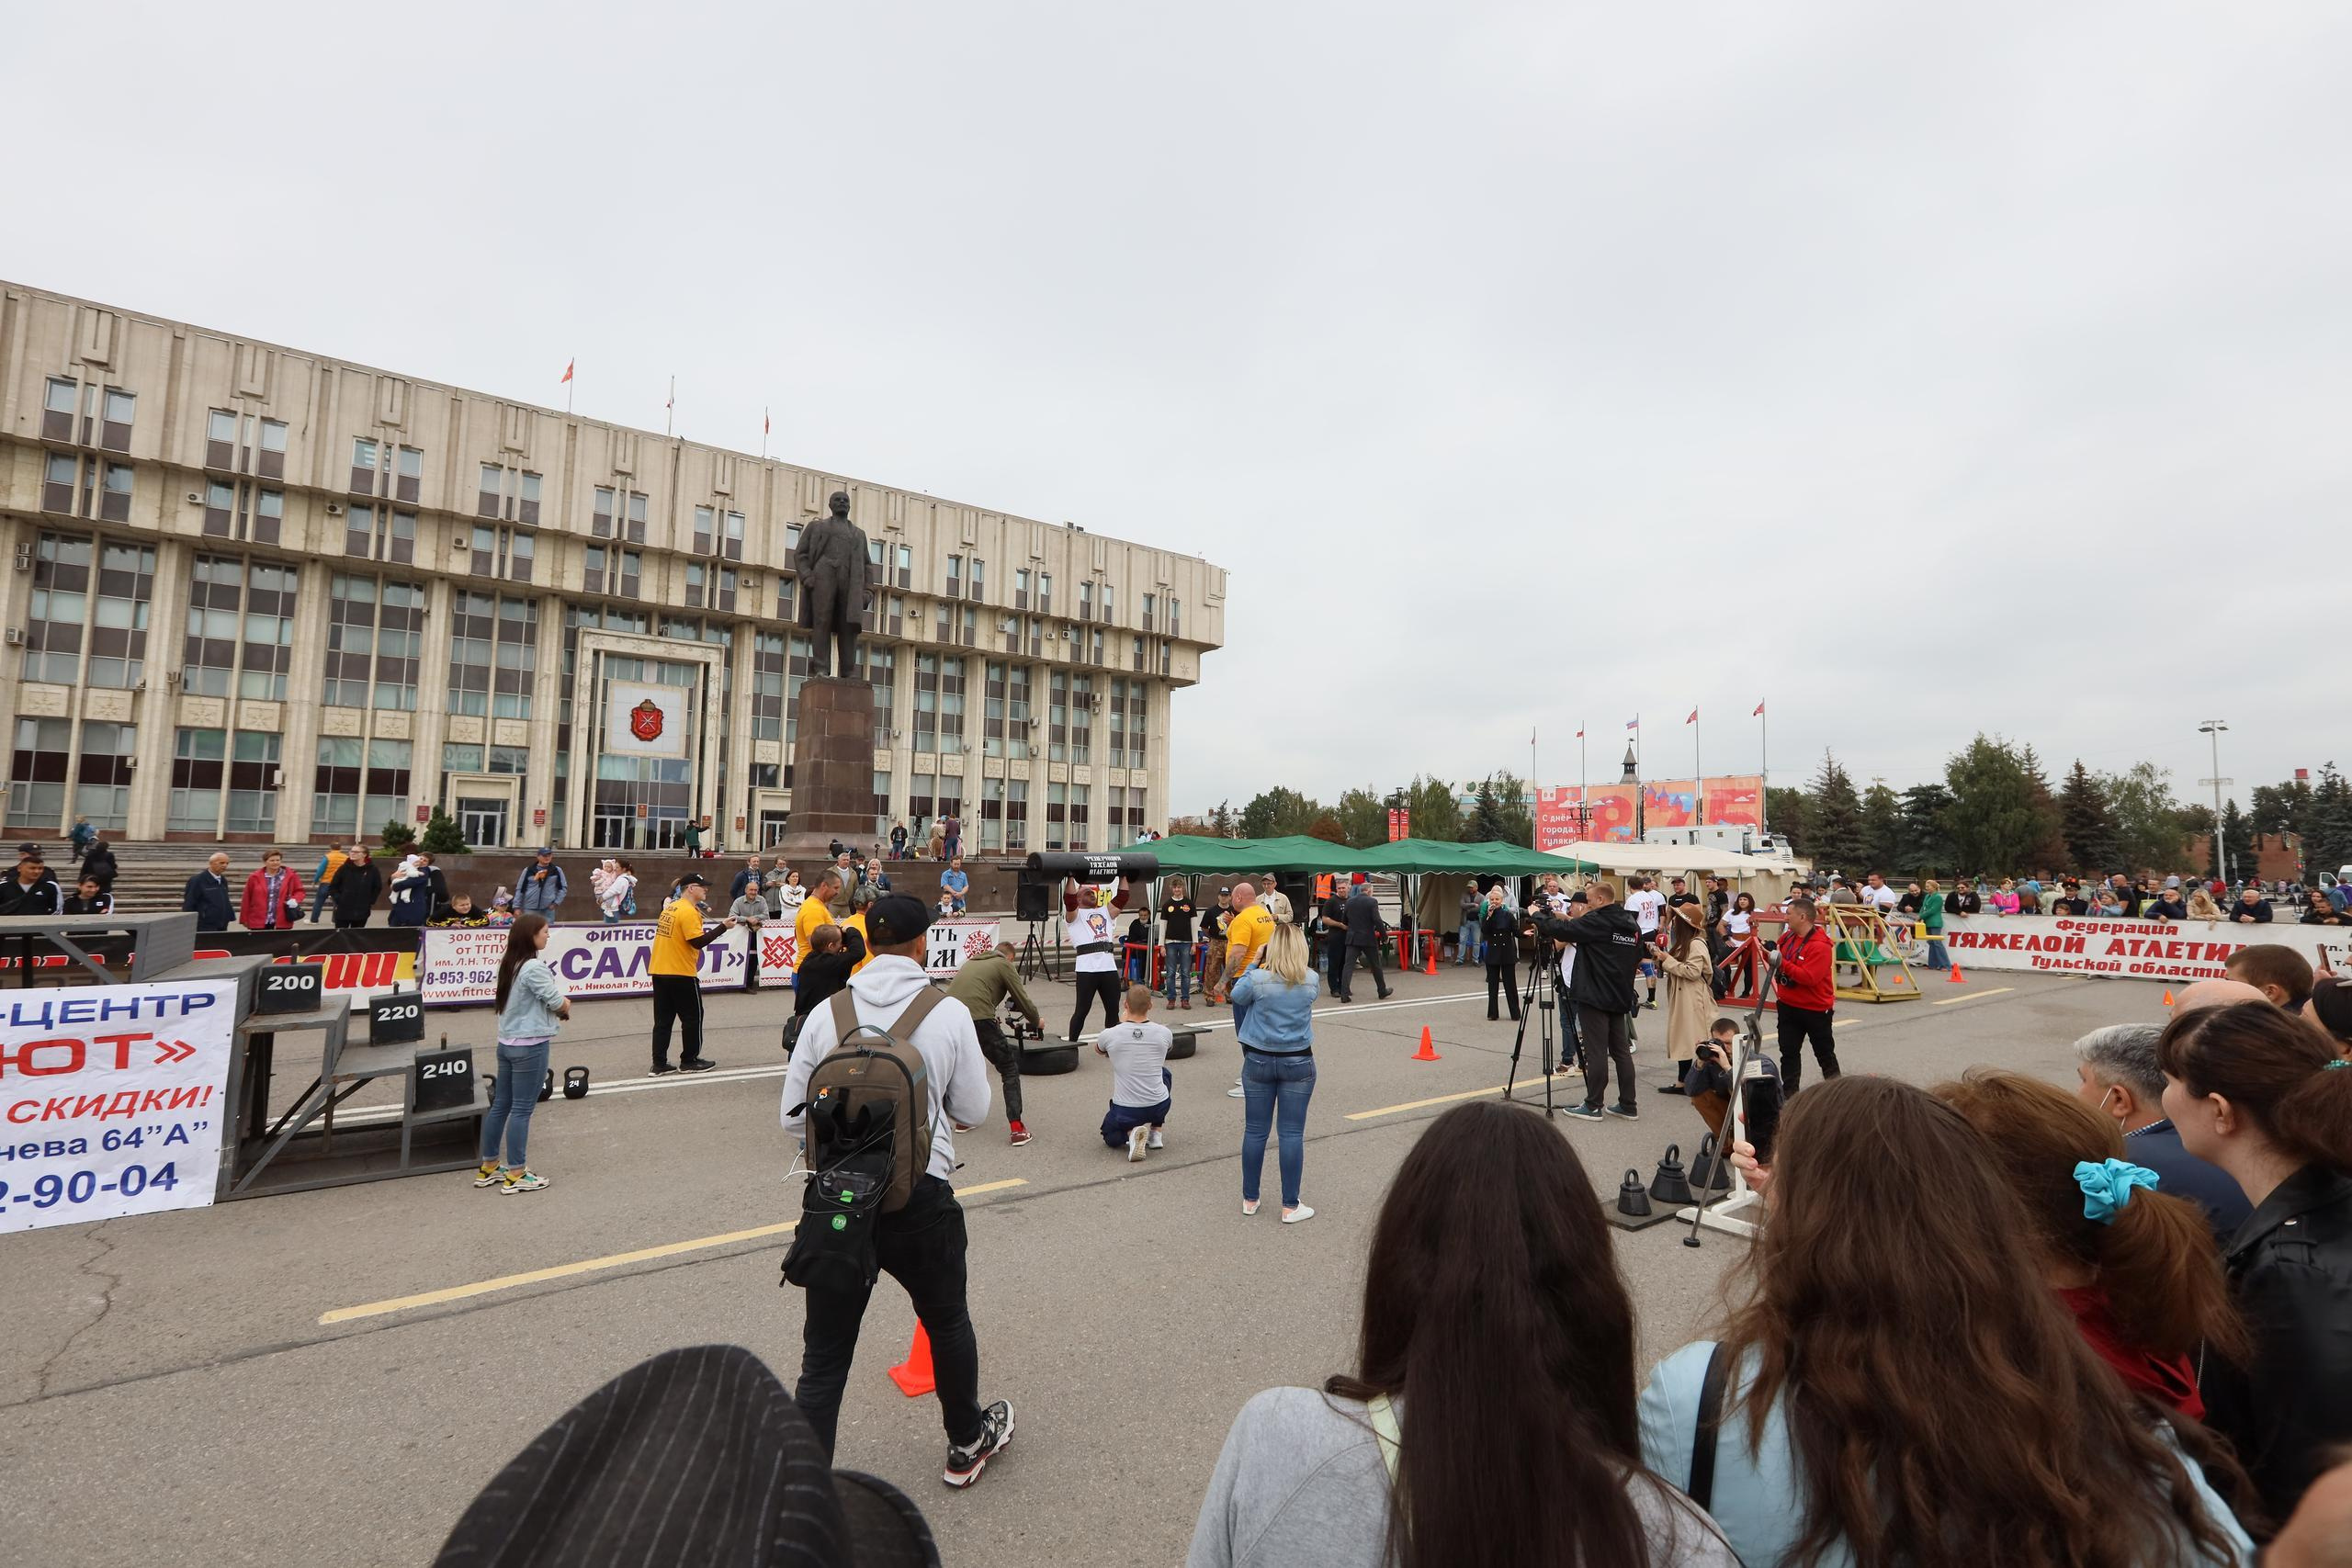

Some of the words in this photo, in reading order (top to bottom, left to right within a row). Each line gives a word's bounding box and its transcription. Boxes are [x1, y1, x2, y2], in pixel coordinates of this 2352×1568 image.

[2055, 919, 2179, 935] Федерация
[448, 933, 471, 943] 300
[1947, 931, 2086, 953] ТЯЖЕЛОЙ
[456, 947, 471, 955] от
[475, 944, 507, 954] ТГПУ
[544, 943, 745, 980] «САЛТ»
[2031, 954, 2121, 972] Тульской
[266, 975, 315, 991] 200
[584, 981, 628, 991] Николая
[377, 1004, 419, 1022] 220
[422, 1058, 468, 1080] 240
[569, 1079, 580, 1089] 24
